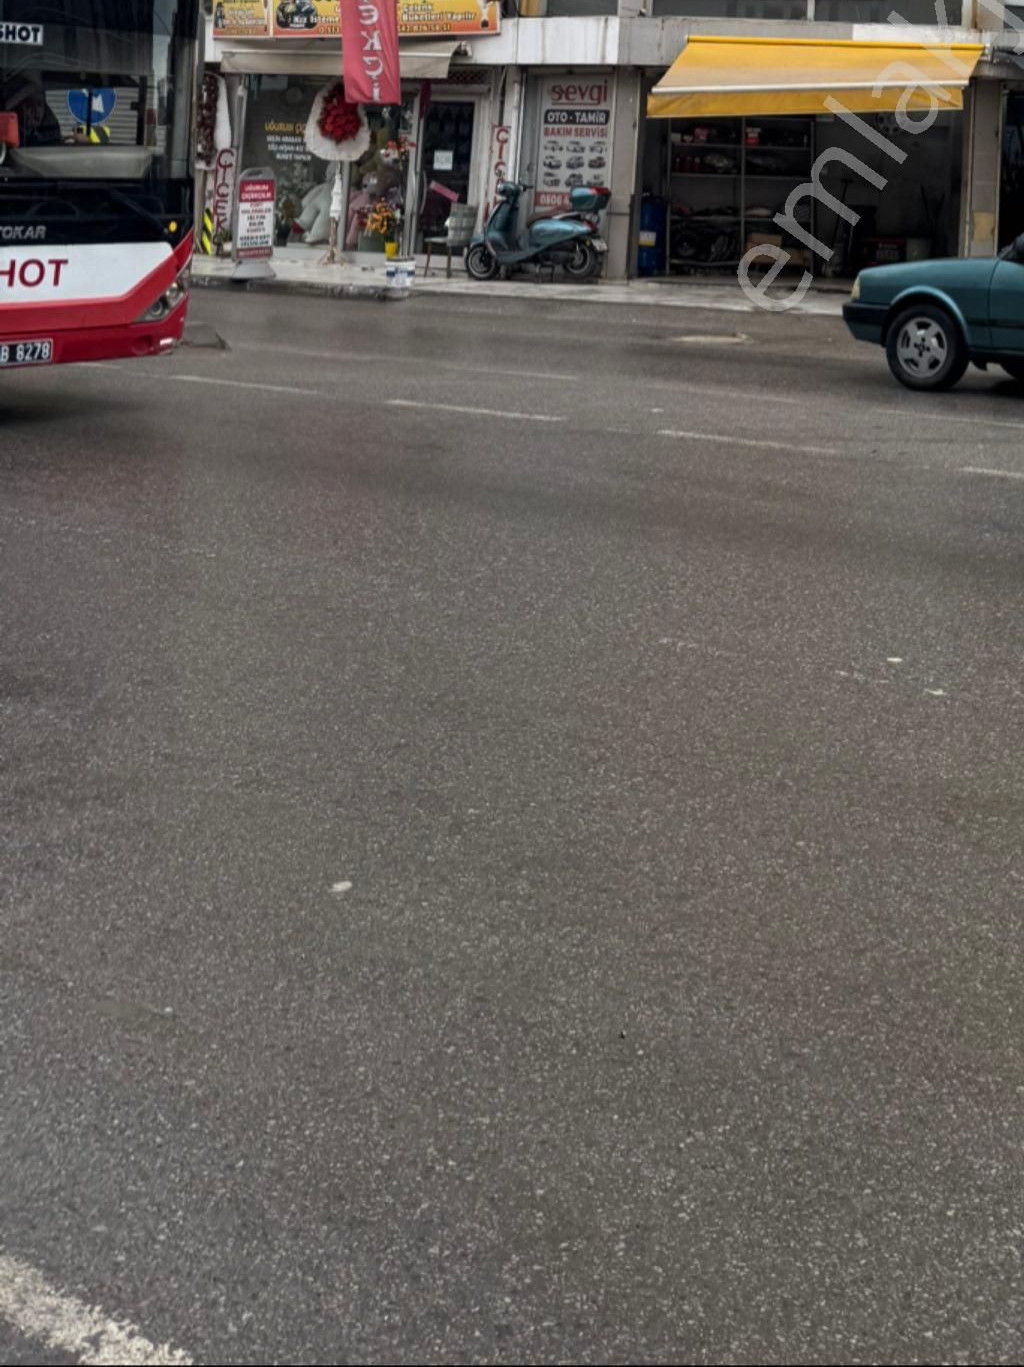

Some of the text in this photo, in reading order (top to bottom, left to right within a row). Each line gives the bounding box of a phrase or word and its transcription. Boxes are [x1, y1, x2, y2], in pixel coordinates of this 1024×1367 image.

[551, 80, 608, 105] sevgi
[547, 112, 566, 123] OTO
[544, 127, 572, 138] BAKIM
[16, 342, 50, 361] 8278
